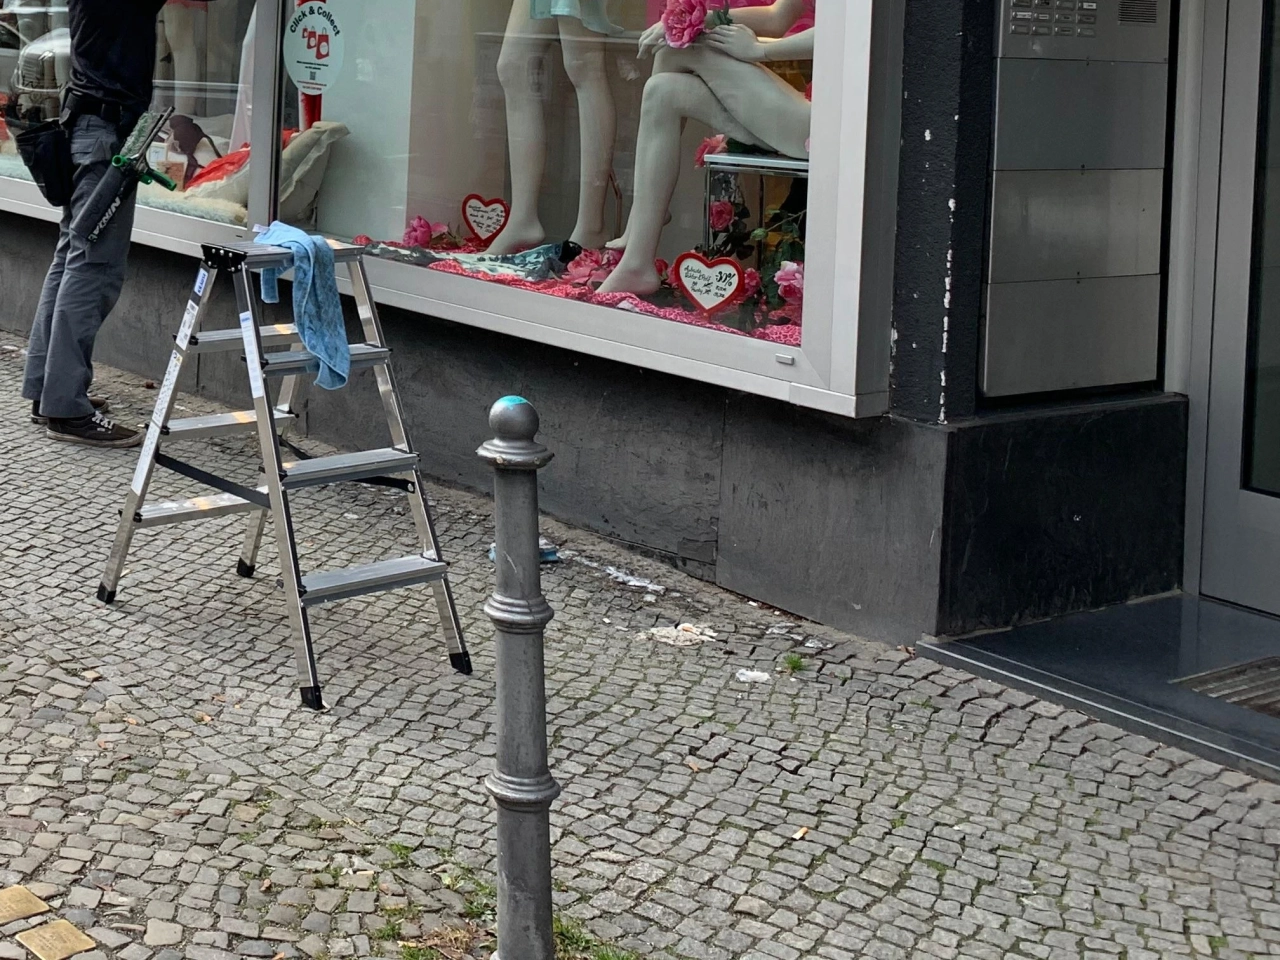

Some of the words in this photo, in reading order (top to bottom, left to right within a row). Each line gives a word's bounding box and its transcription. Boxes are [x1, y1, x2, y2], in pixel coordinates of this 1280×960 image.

[290, 10, 308, 33] Click
[308, 6, 316, 15] &
[317, 6, 341, 37] Collect
